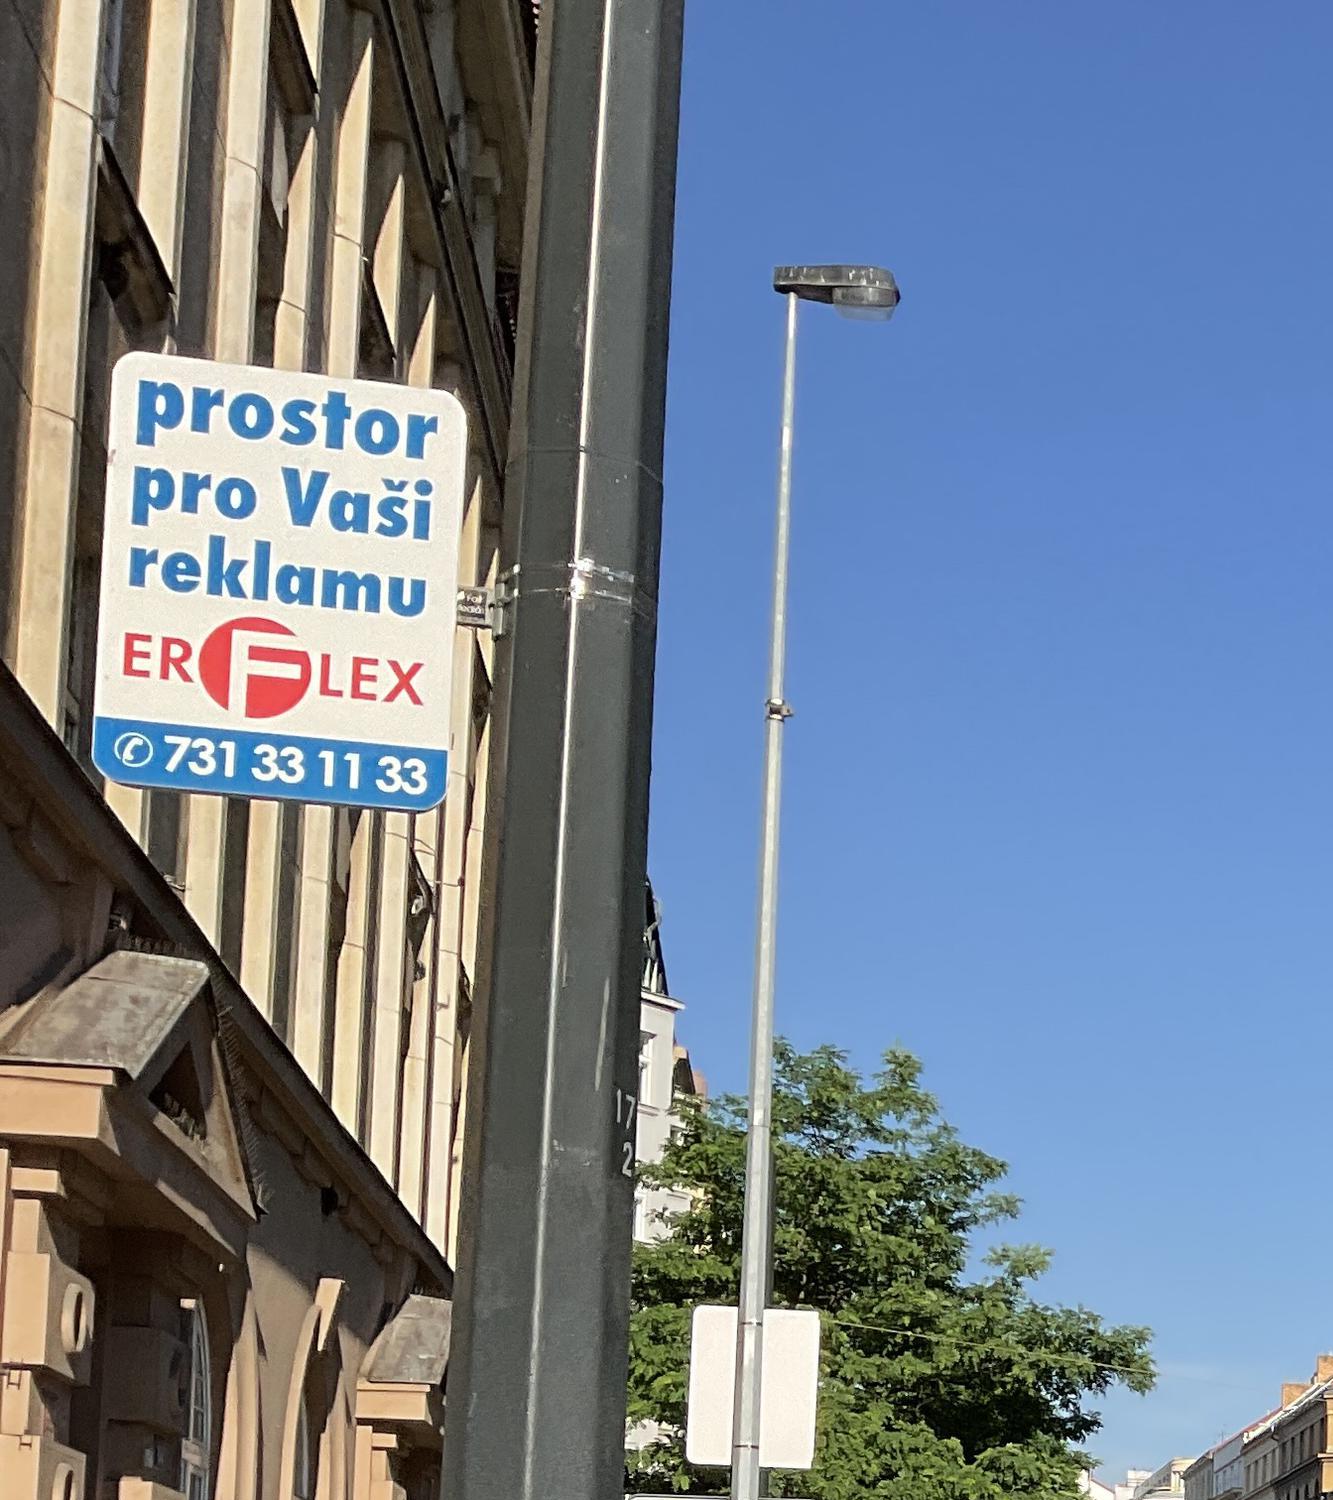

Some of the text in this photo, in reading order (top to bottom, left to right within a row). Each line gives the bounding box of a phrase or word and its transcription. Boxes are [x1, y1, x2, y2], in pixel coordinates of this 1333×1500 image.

[135, 378, 439, 461] prostor
[131, 466, 434, 541] pro Vaši
[127, 535, 427, 618] reklamu
[122, 616, 425, 719] ERFLEX
[163, 735, 428, 796] 731 33 11 33
